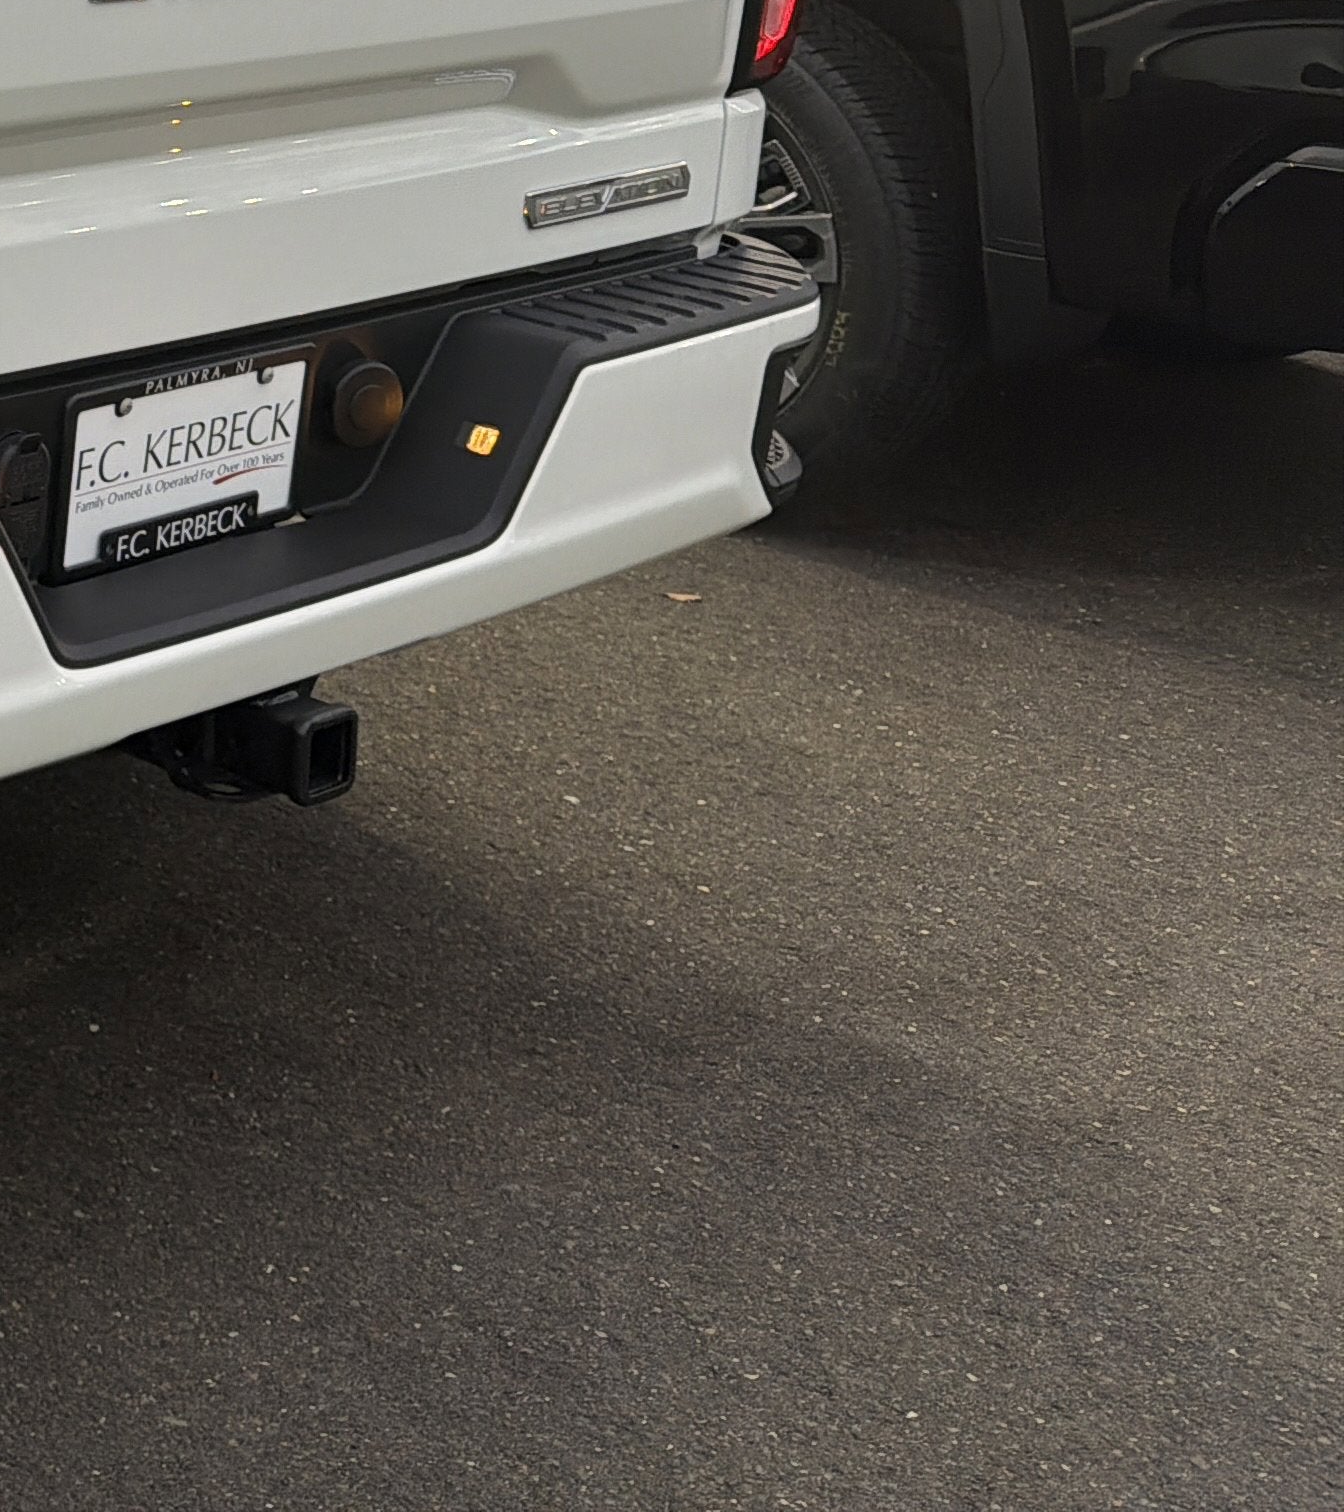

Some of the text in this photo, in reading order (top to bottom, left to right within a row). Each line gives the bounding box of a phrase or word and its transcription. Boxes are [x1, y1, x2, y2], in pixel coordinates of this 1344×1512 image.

[145, 358, 255, 394] PALMYRA, NJ
[75, 400, 295, 491] F.C. KERBECK
[75, 451, 285, 514] Family Owned & Operated For Over 100 Years
[116, 502, 248, 562] F.C. KERBECK
